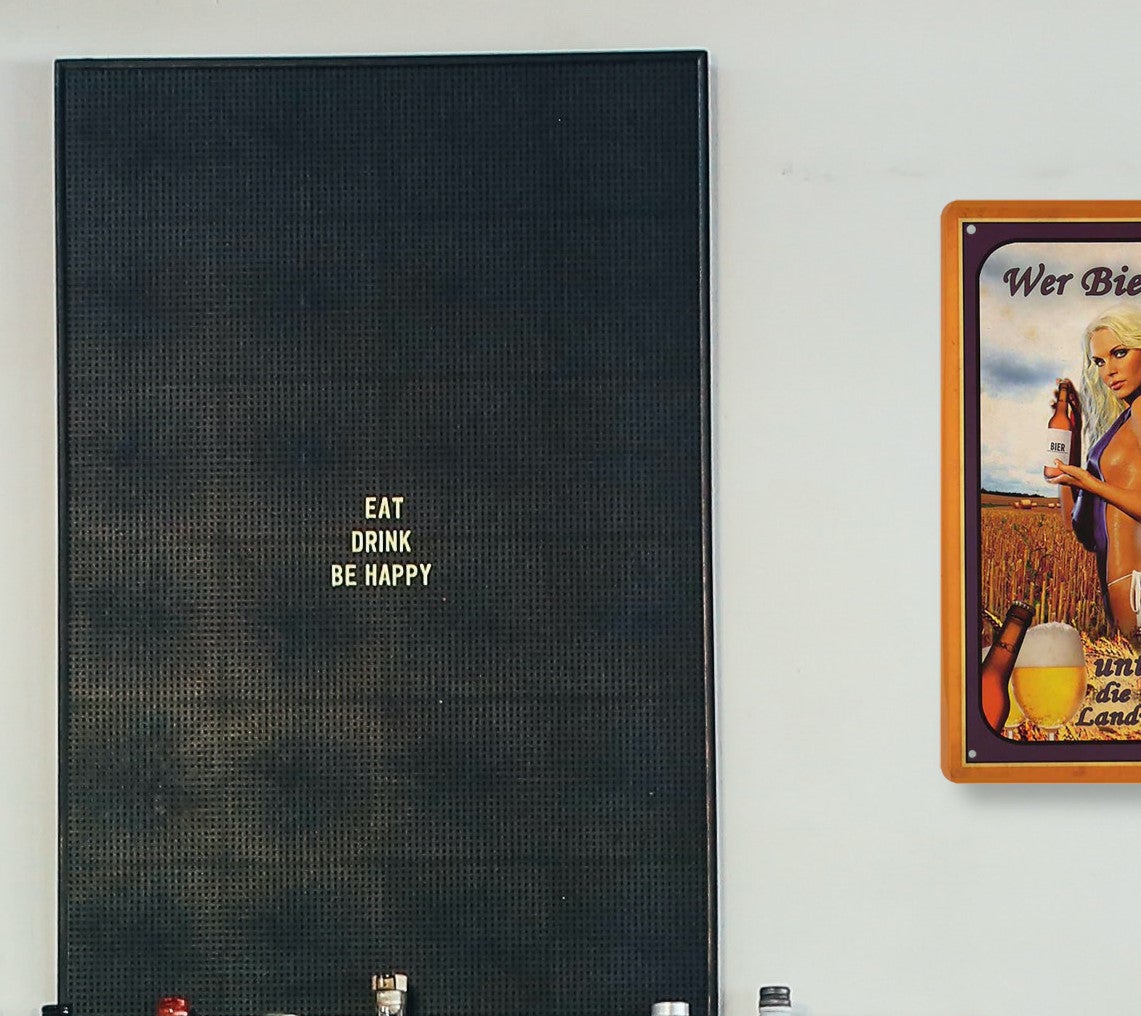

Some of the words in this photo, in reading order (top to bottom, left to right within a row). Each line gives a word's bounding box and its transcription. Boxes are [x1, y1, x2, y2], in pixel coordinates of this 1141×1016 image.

[1004, 266, 1073, 298] Wer
[1050, 441, 1065, 452] BIER
[365, 496, 404, 520] EAT
[351, 529, 412, 554] DRINK
[331, 563, 358, 587] BE
[365, 563, 432, 587] HAPPY
[1096, 682, 1131, 704] die
